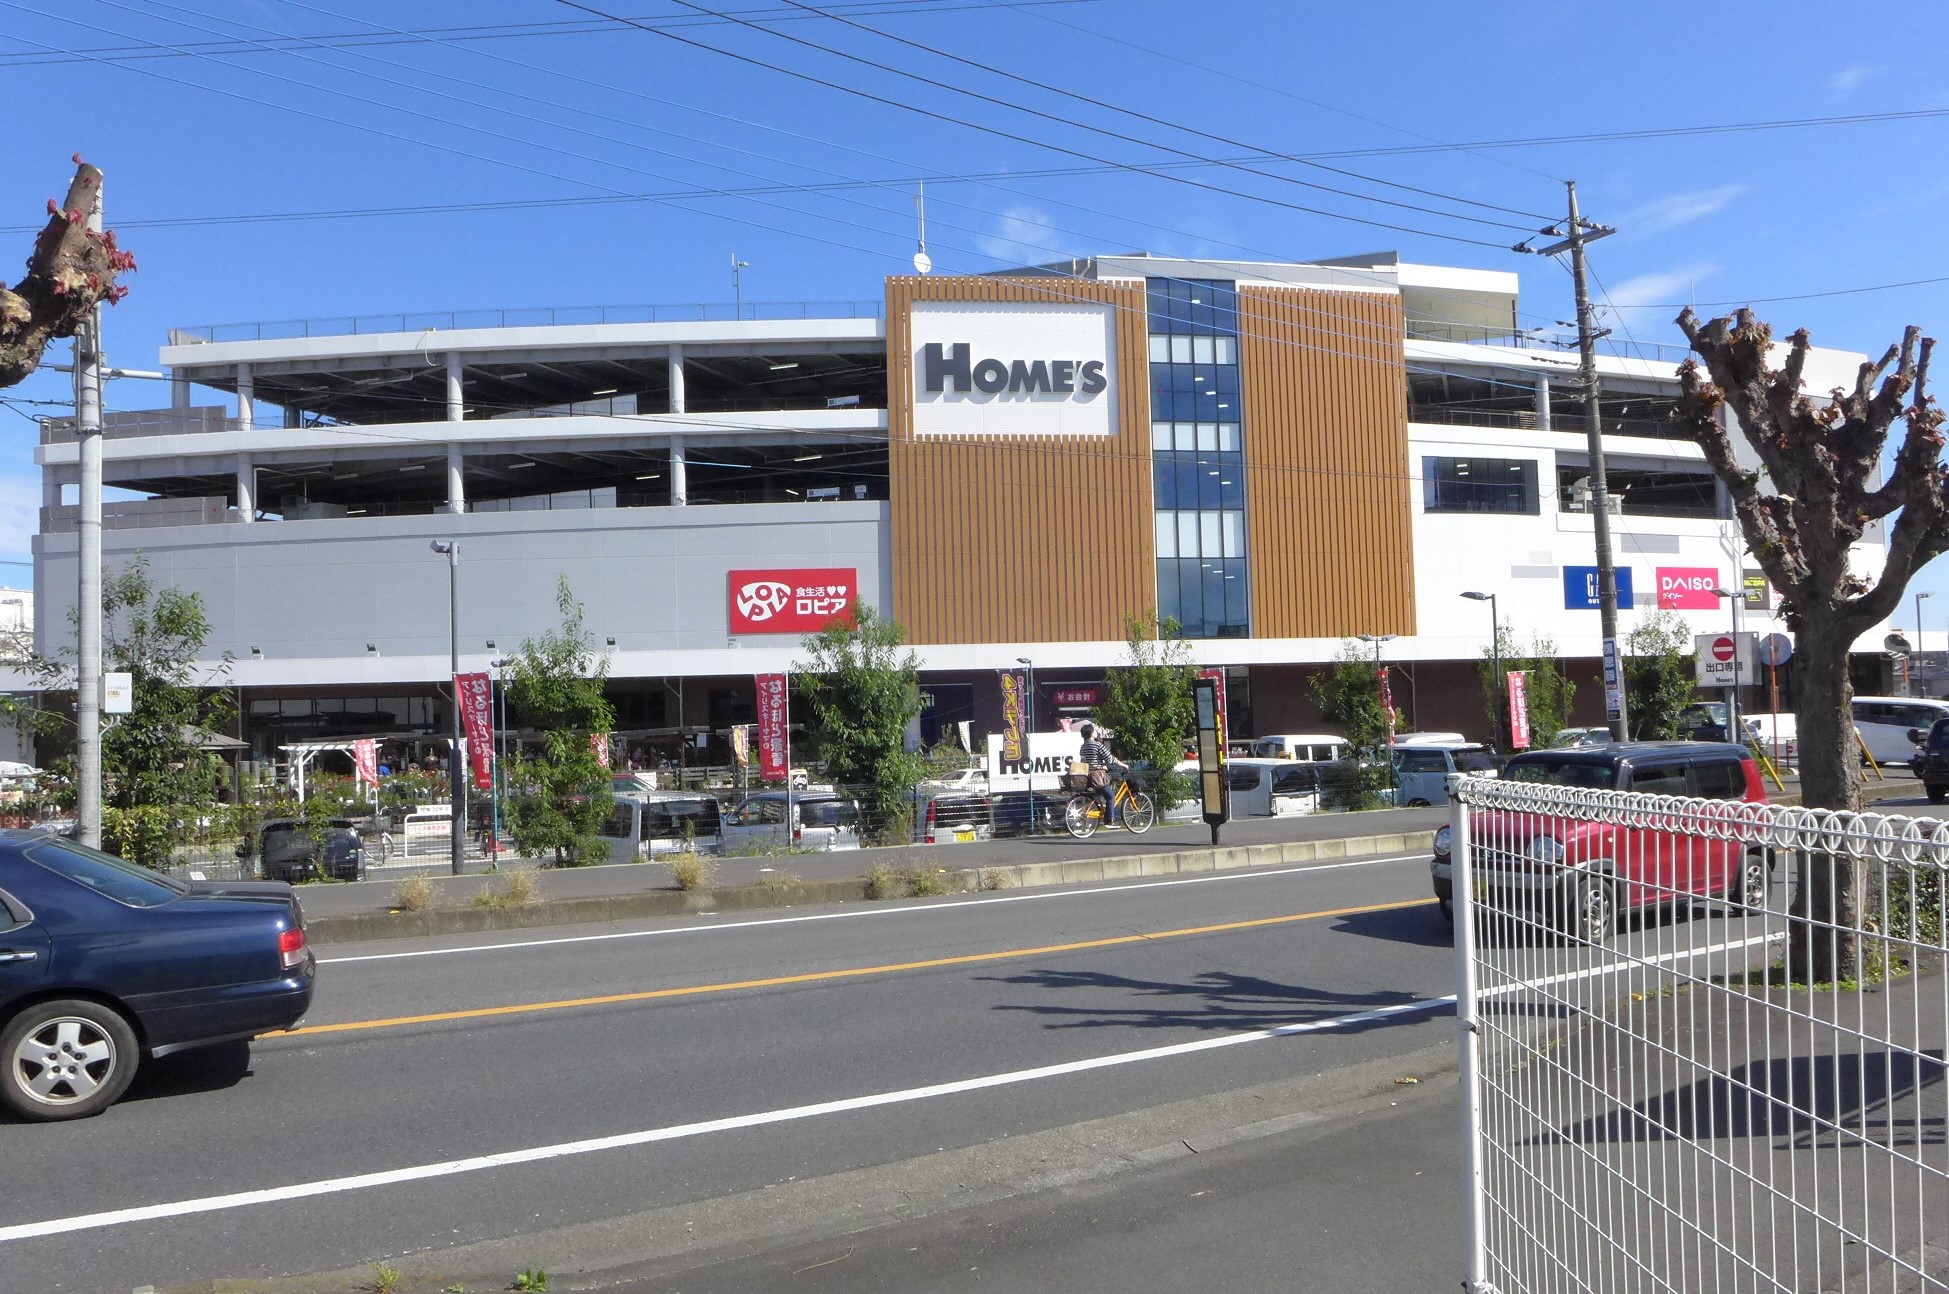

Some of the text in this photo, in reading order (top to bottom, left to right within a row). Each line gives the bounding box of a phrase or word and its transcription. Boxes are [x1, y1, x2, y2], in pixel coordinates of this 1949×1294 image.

[925, 342, 1107, 394] HOME'S
[1661, 576, 1714, 591] DAISO
[795, 586, 825, 597] 食生活
[796, 597, 847, 615] ロピア
[1706, 661, 1744, 673] 出口専用
[1067, 692, 1091, 701] お会計
